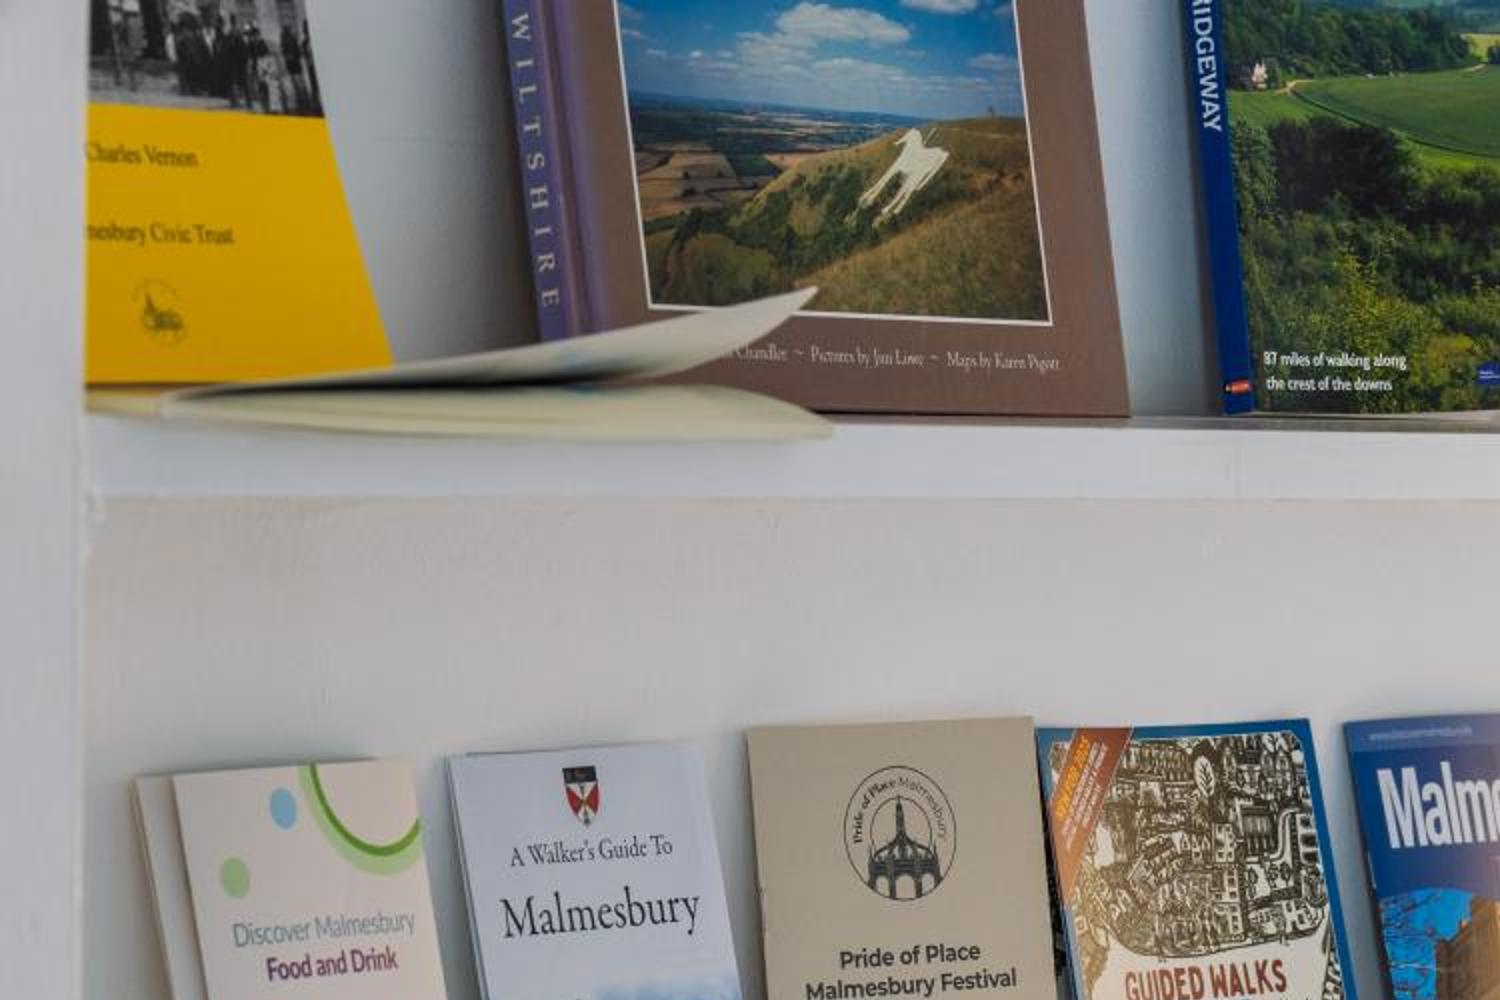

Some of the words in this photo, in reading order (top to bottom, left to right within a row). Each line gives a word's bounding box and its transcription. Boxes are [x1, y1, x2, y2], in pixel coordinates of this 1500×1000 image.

[143, 144, 199, 167] Vernon
[511, 12, 559, 308] WILTSHIRE
[193, 224, 236, 246] Trust
[946, 351, 976, 370] Maps
[1263, 351, 1278, 366] 87
[1280, 351, 1311, 367] miles
[1313, 352, 1325, 367] of
[1326, 352, 1371, 371] walking
[1373, 352, 1408, 371] along
[1266, 376, 1286, 391] the
[1287, 377, 1317, 391] crest
[1318, 376, 1330, 391] of
[1331, 376, 1353, 391] the
[1353, 377, 1393, 391] downs
[511, 847, 526, 868] A
[528, 839, 595, 866] Walker's
[598, 835, 647, 861] Guide
[649, 834, 673, 855] To
[499, 885, 700, 939] Malmesbury
[231, 920, 310, 948] Discover
[314, 911, 415, 940] Malmesbury
[266, 952, 313, 982] Food
[316, 950, 348, 976] and
[350, 946, 399, 974] Drink
[839, 947, 895, 971] Pride
[899, 944, 921, 966] of
[925, 942, 981, 963] Place
[941, 967, 1018, 995] Festival
[1209, 959, 1288, 999] WALKS
